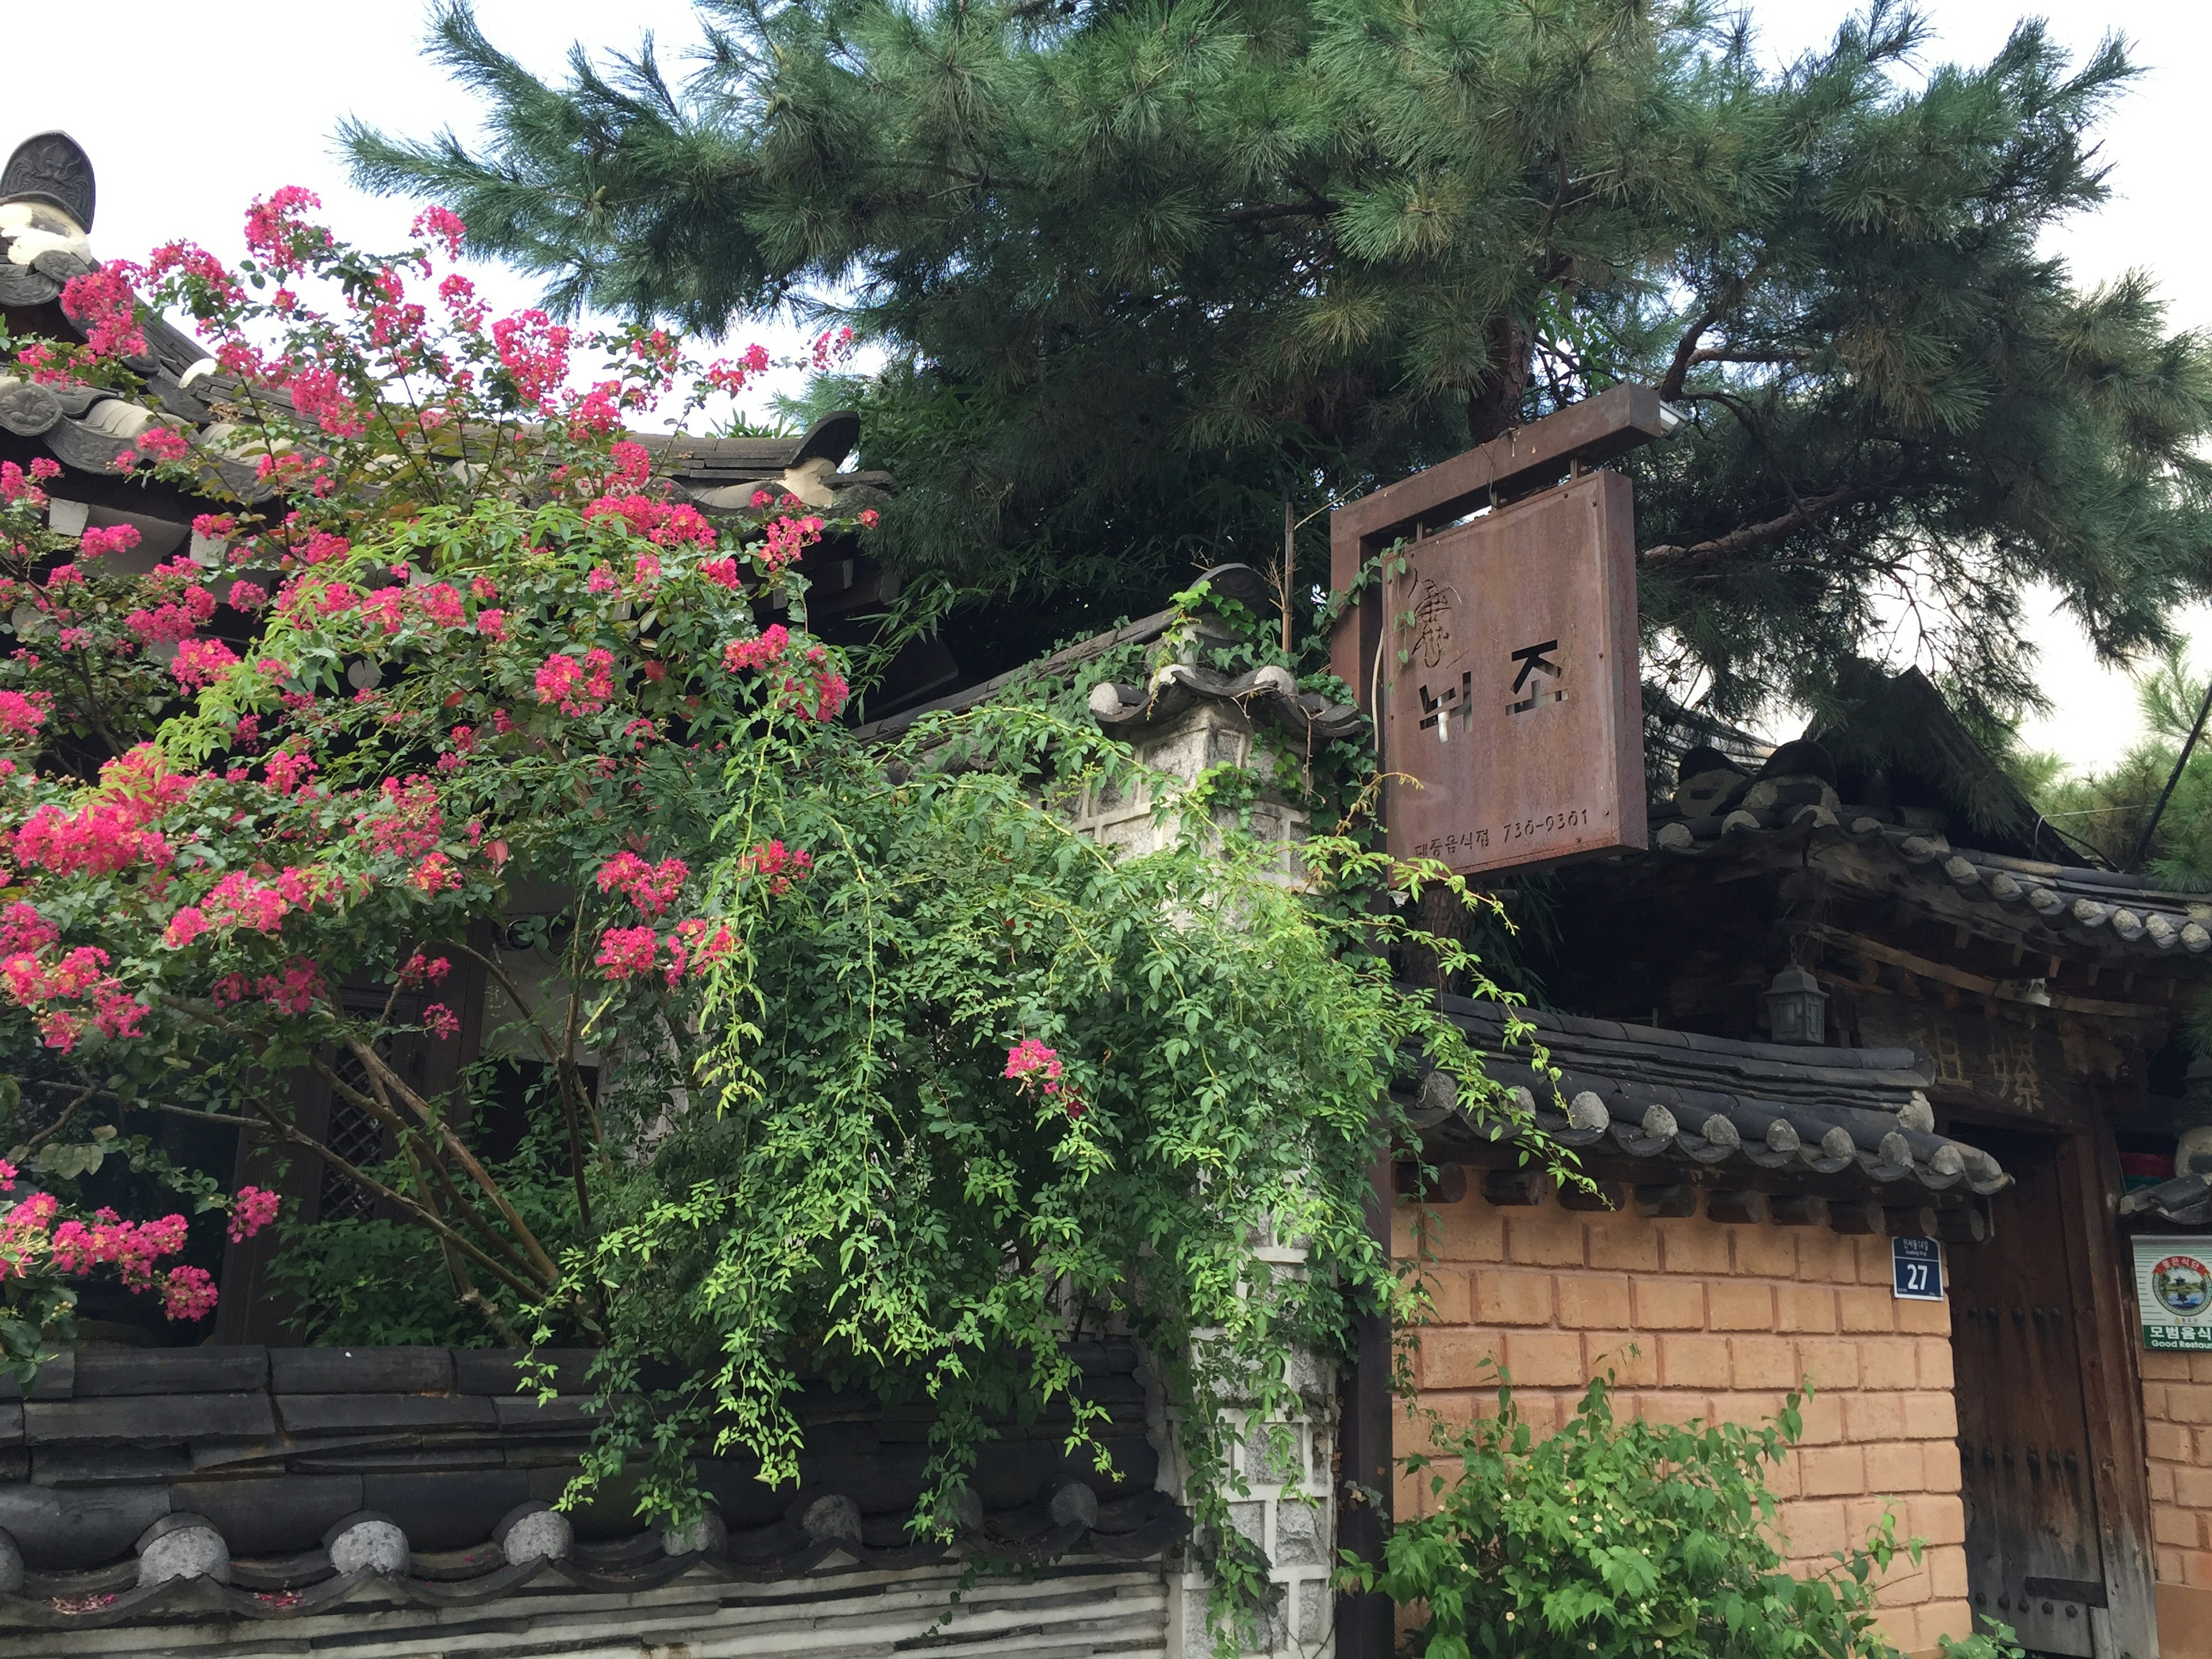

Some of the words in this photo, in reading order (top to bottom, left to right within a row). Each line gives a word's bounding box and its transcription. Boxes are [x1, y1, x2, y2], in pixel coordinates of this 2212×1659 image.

[1419, 639, 1569, 743] 뉘조
[1415, 828, 1490, 858] 대중음식점
[1503, 808, 1588, 843] 730-9301
[1907, 1263, 1928, 1290] 27
[2152, 1339, 2178, 1349] Good
